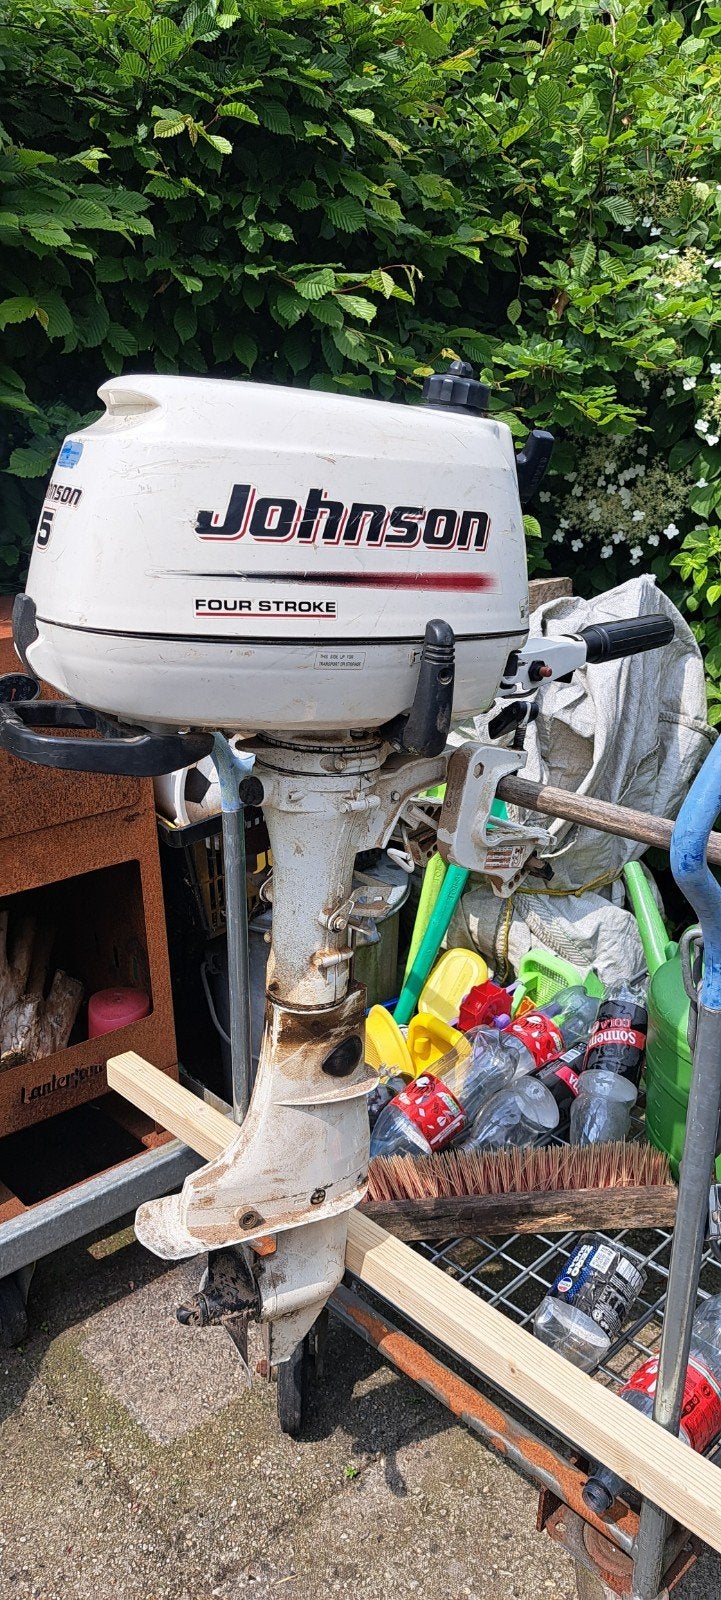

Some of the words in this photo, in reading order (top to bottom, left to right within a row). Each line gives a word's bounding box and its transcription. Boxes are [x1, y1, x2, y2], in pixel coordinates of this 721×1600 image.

[37, 510, 54, 546] 5
[195, 484, 492, 552] Johnson
[195, 599, 252, 613] FOUR
[258, 600, 337, 614] STROKE
[570, 1244, 594, 1277] ZERO
